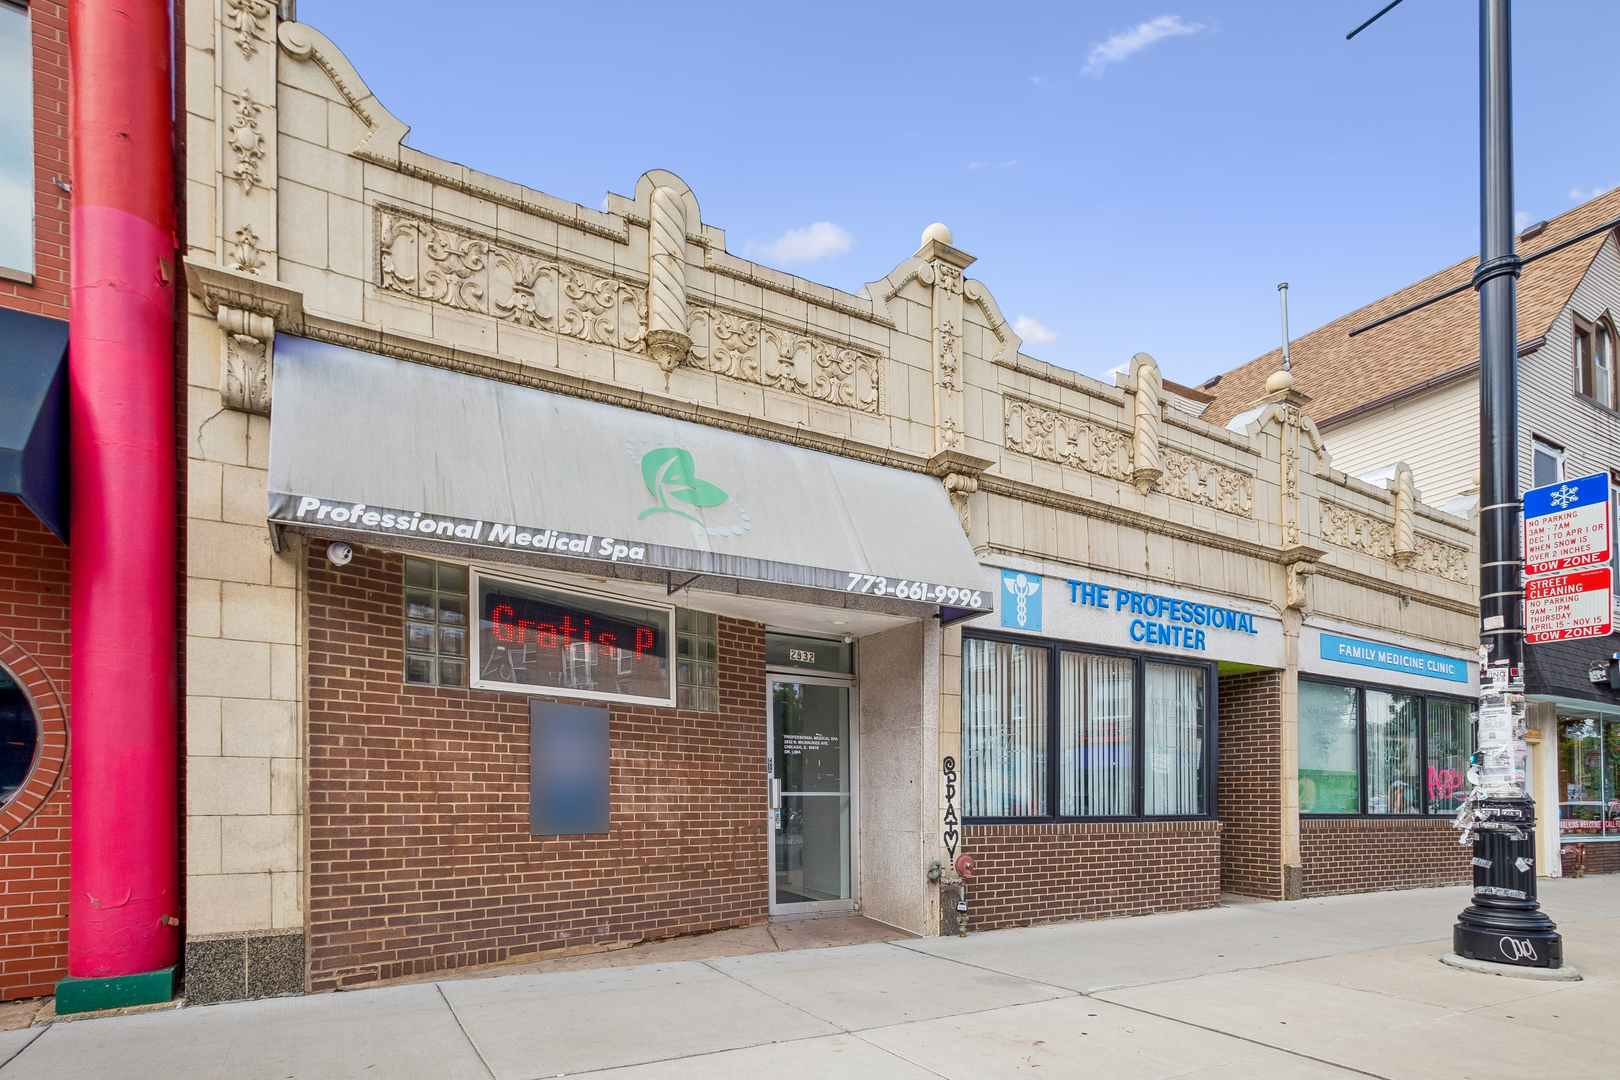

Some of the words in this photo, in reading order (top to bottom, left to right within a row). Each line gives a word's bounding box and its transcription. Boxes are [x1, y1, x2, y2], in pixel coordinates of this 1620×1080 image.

[1529, 520, 1539, 528] NO
[1543, 511, 1578, 525] PARKING
[296, 497, 484, 540] Professional
[488, 523, 593, 553] Medical
[598, 537, 645, 561] Spa
[1529, 526, 1545, 536] 3AM
[1553, 522, 1570, 531] 7AM
[1529, 535, 1544, 545] DEC
[1553, 532, 1562, 540] TO
[1566, 528, 1583, 538] APR
[1592, 523, 1604, 532] OR
[1529, 543, 1551, 553] WHEN
[1554, 538, 1576, 548] SNOW
[1529, 552, 1550, 562] OVER
[1552, 550, 1558, 558] 2
[1560, 544, 1591, 556] INCHES
[1531, 560, 1560, 573] TOW
[1563, 552, 1601, 568] ZONE
[846, 573, 982, 608] 773-661-9996
[1530, 576, 1568, 591] STREET
[1530, 583, 1583, 599] CLEANING
[1066, 578, 1110, 609] THE
[1116, 589, 1258, 635] PROFESSIONAL
[1530, 600, 1541, 608] NO
[1544, 595, 1580, 606] PARKING
[1530, 607, 1546, 616] 9AM
[1555, 604, 1570, 612] 1PM
[1530, 612, 1572, 624] THURSDAY
[1530, 623, 1553, 632] APRIL
[1556, 620, 1564, 628] 15
[1573, 617, 1591, 626] NOV
[492, 604, 617, 657] Gratis
[636, 627, 654, 660] P
[1130, 618, 1206, 651] CENTER
[1533, 630, 1561, 642] TOW
[1564, 625, 1602, 638] ZONE
[1339, 643, 1375, 662] FAMILY
[1378, 651, 1424, 670] MEDICINE
[1427, 661, 1454, 675] CLINIC
[1580, 820, 1602, 829] WELCOME
[1605, 820, 1615, 828] CALL
